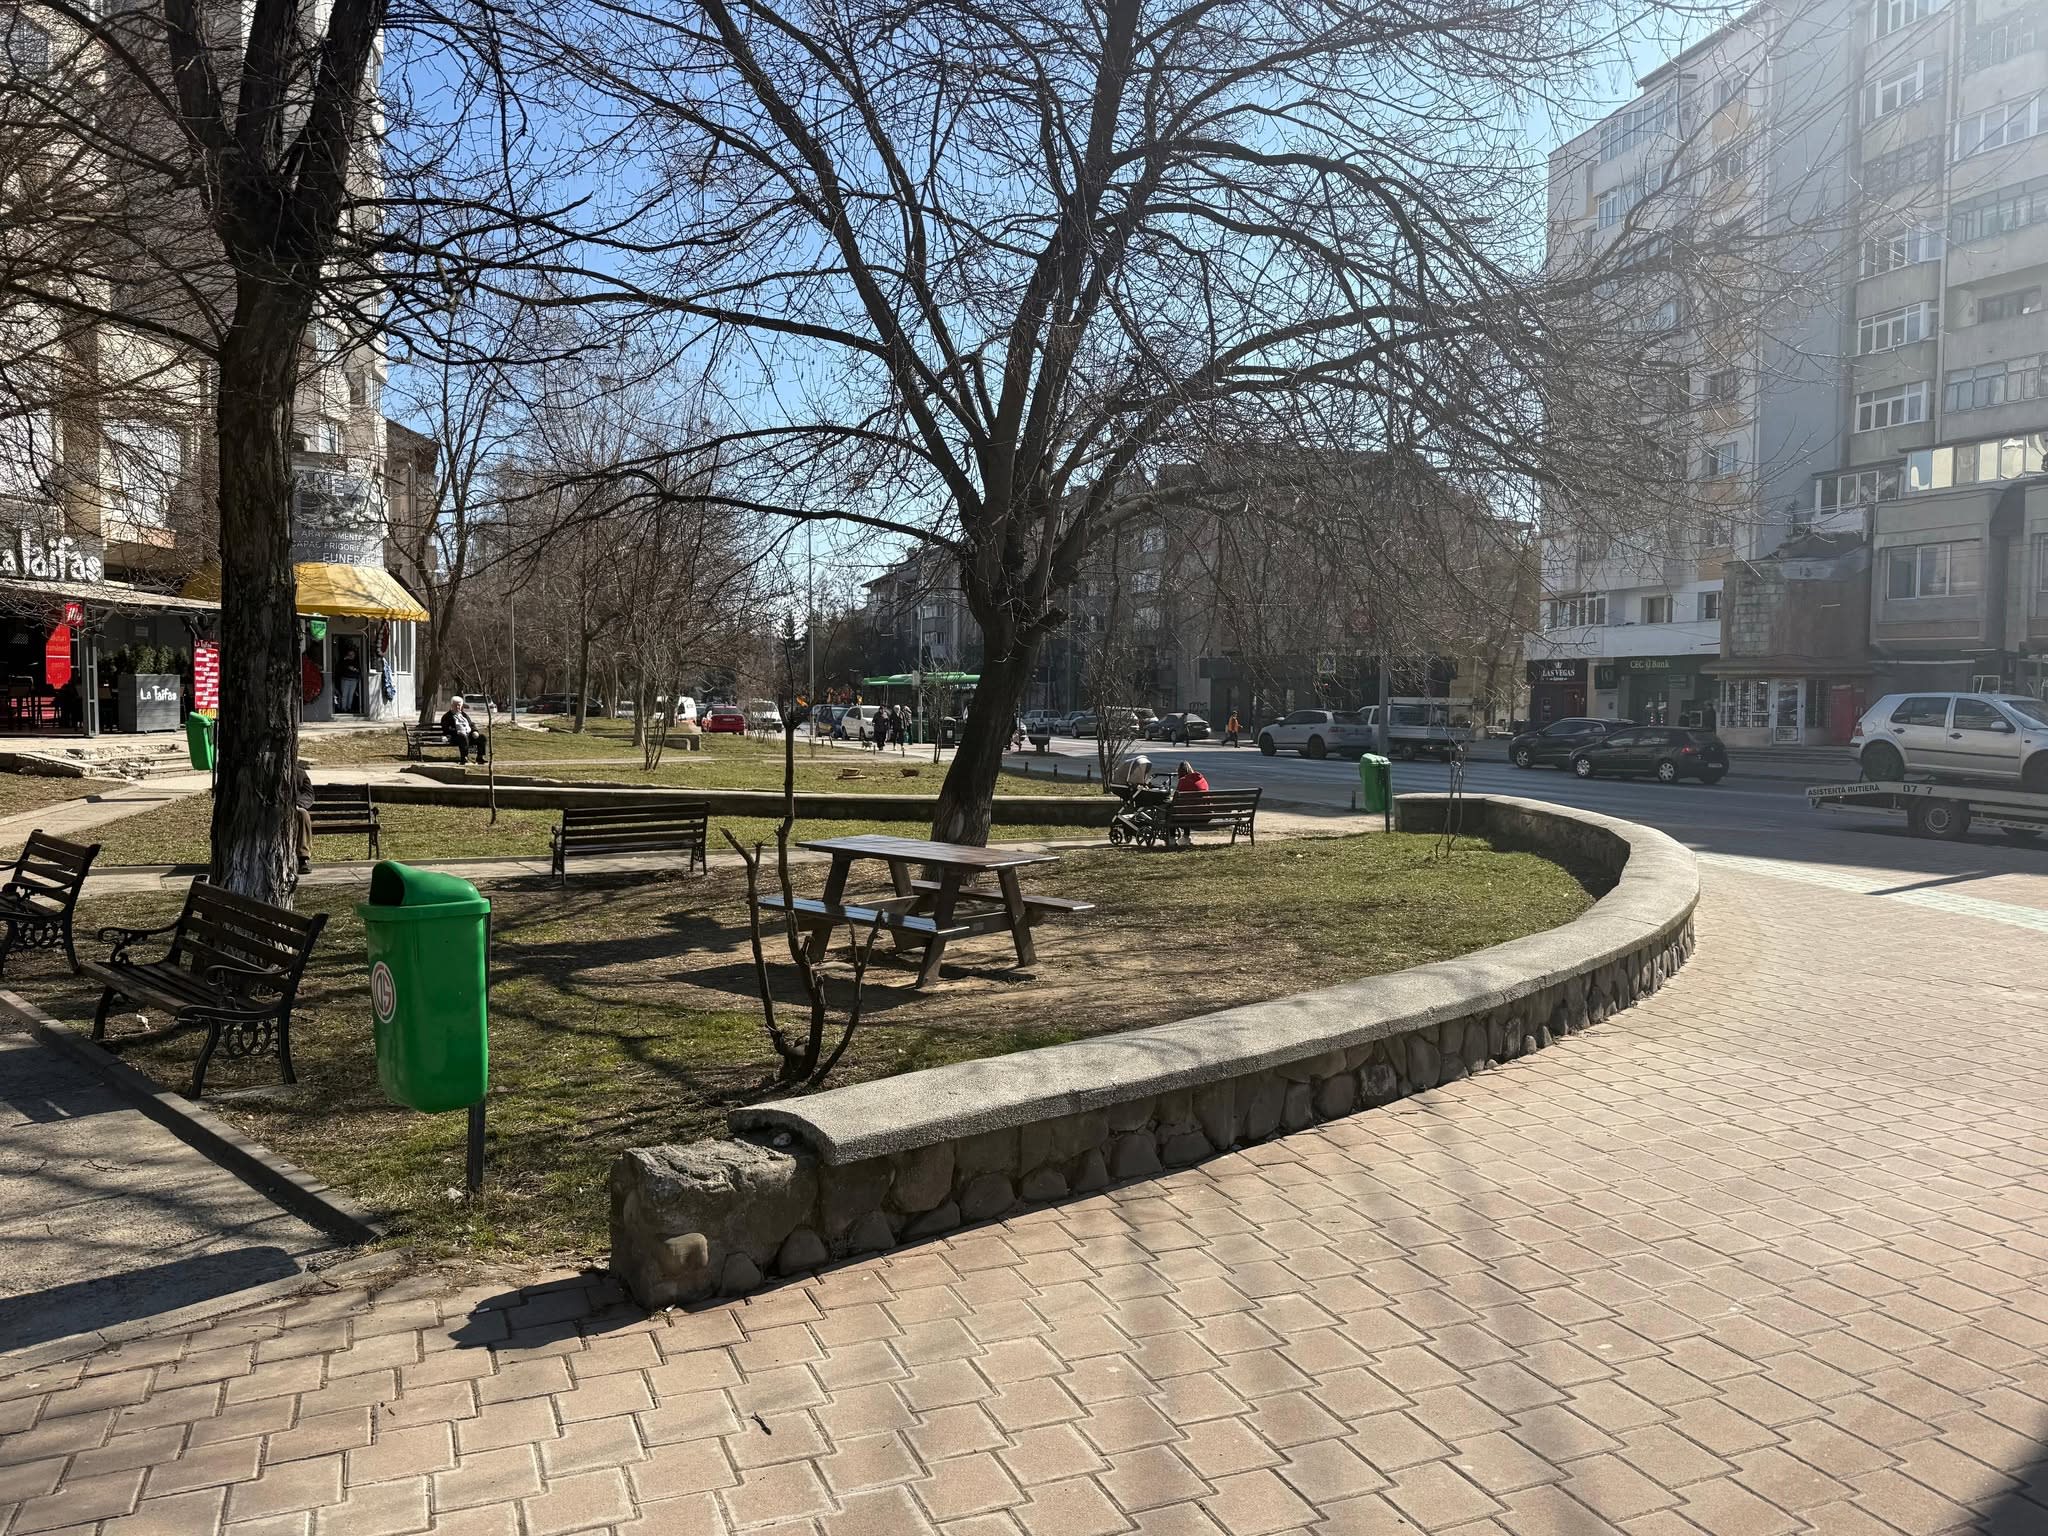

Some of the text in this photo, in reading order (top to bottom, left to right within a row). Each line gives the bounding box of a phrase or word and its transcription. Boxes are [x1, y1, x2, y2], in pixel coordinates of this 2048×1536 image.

[1630, 660, 1670, 669] CEC Bank
[1542, 669, 1575, 677] LAS VEGAS
[140, 685, 177, 701] La Taifas
